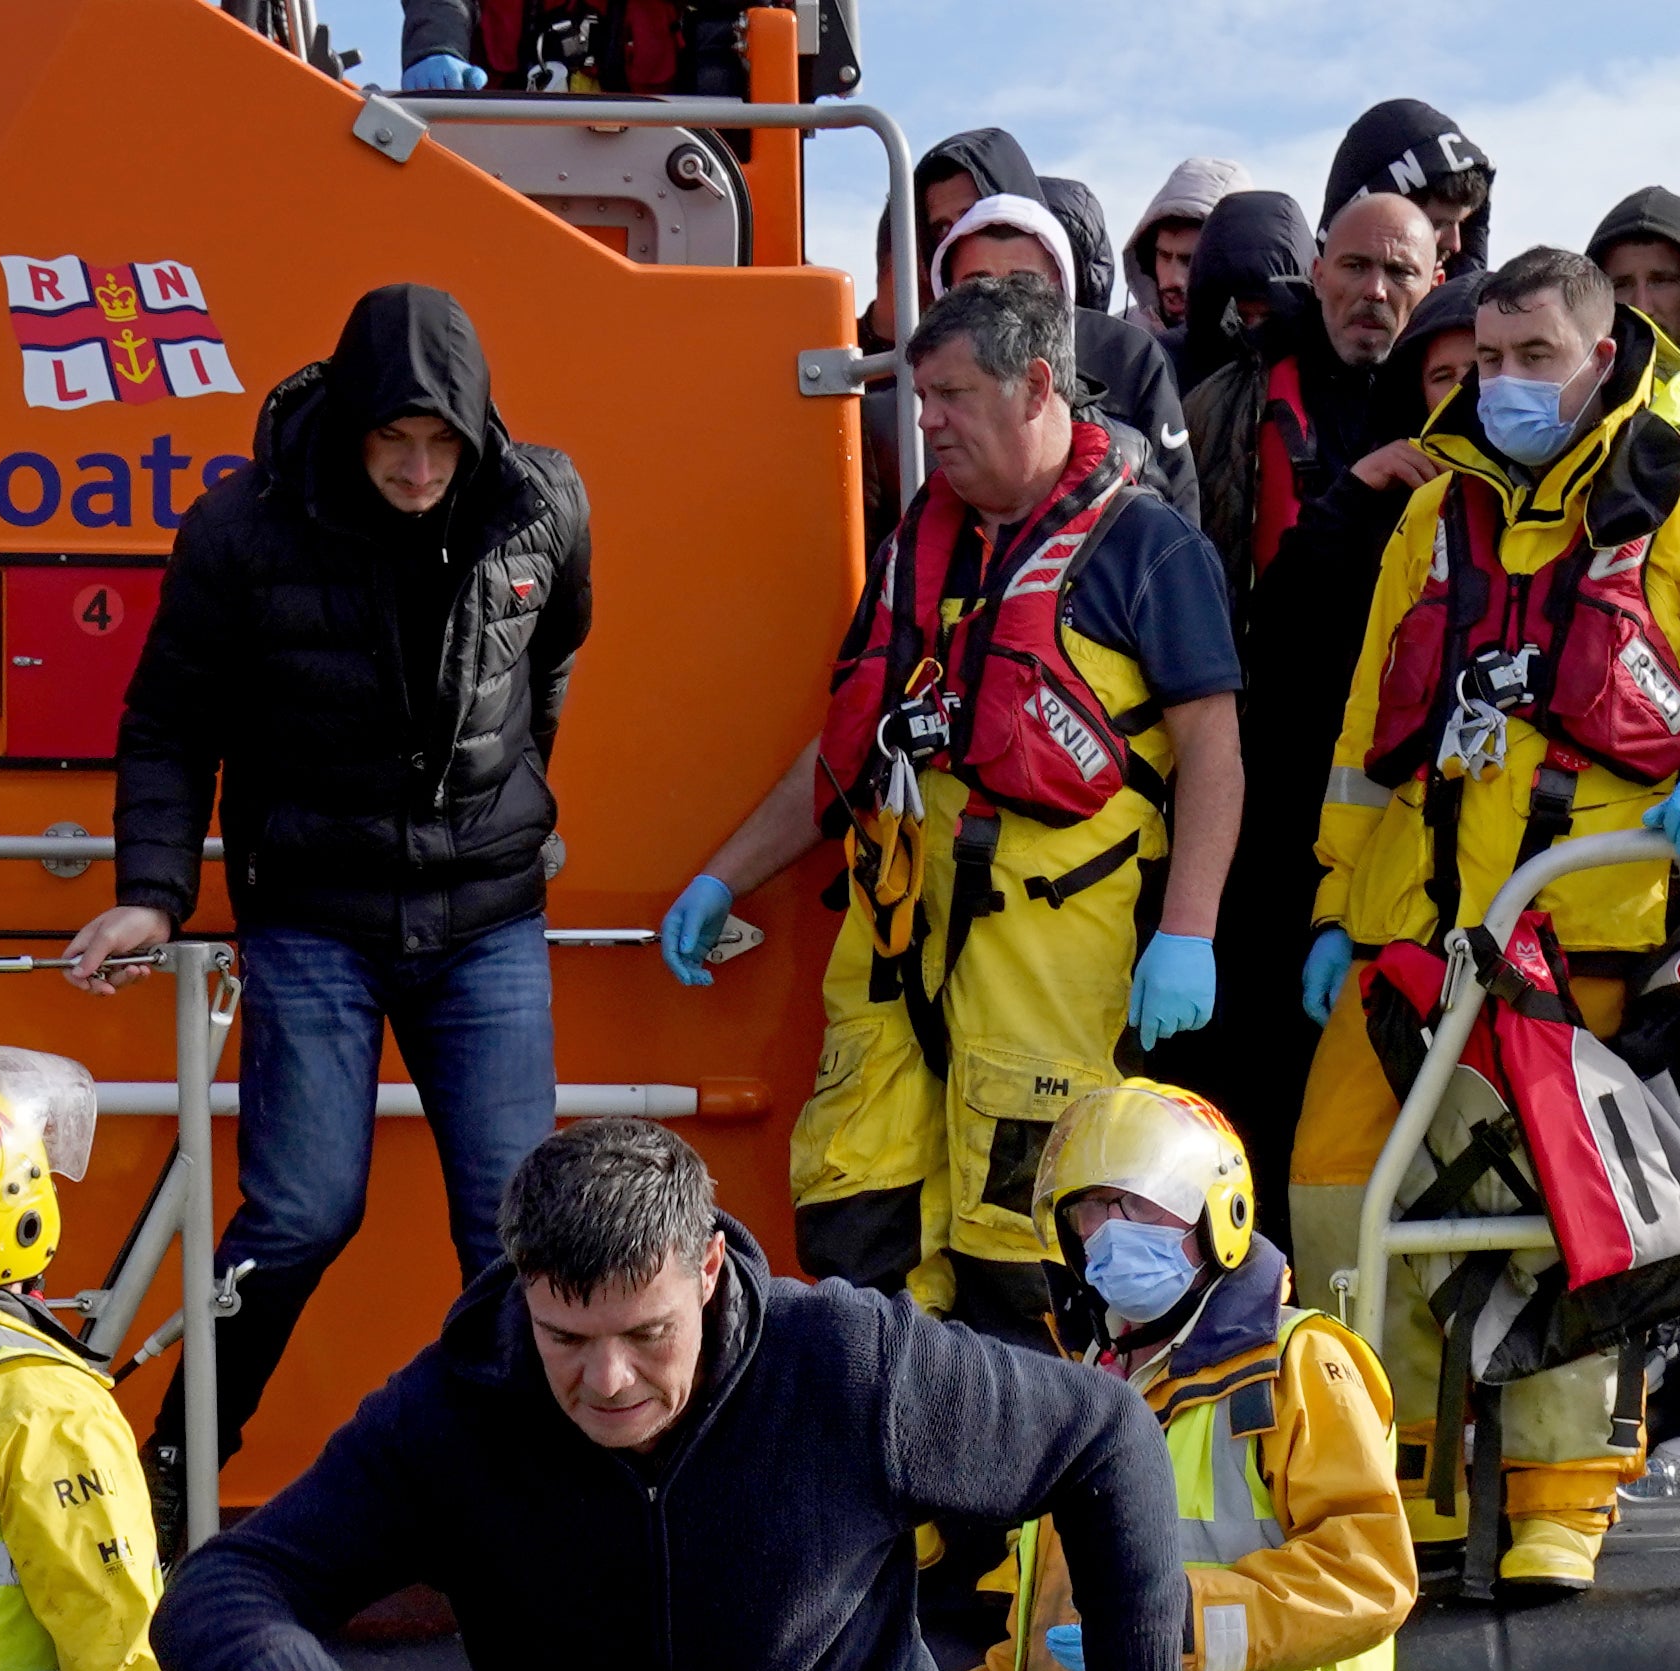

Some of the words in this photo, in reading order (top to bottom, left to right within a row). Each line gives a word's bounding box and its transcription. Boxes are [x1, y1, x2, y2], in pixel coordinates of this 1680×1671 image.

[28, 264, 65, 301] R
[160, 265, 192, 299] N
[53, 359, 88, 402] L
[82, 588, 113, 632] 4
[1041, 697, 1100, 769] RNLI
